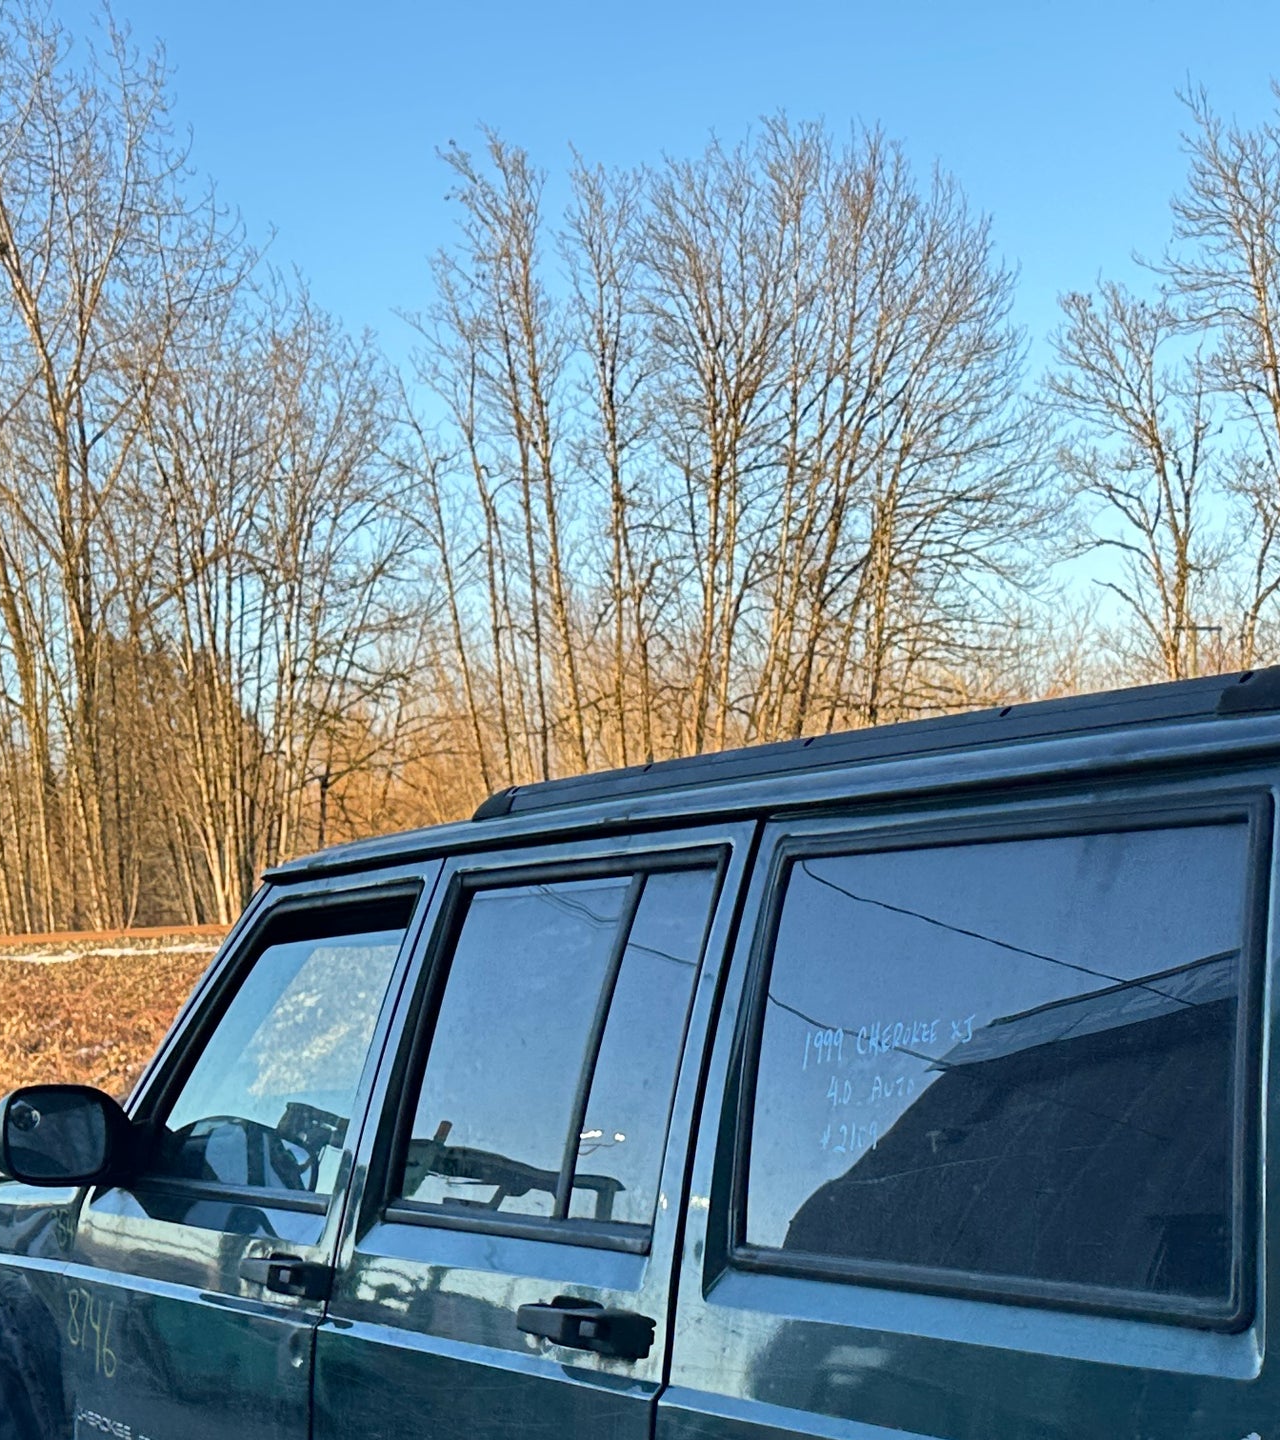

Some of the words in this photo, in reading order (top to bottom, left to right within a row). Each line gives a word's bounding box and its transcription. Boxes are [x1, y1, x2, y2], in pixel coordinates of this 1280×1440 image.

[801, 1028, 844, 1071] 1999
[856, 1019, 941, 1056] CHEROKEE
[950, 1014, 976, 1044] XJ
[69, 1287, 117, 1378] 8746
